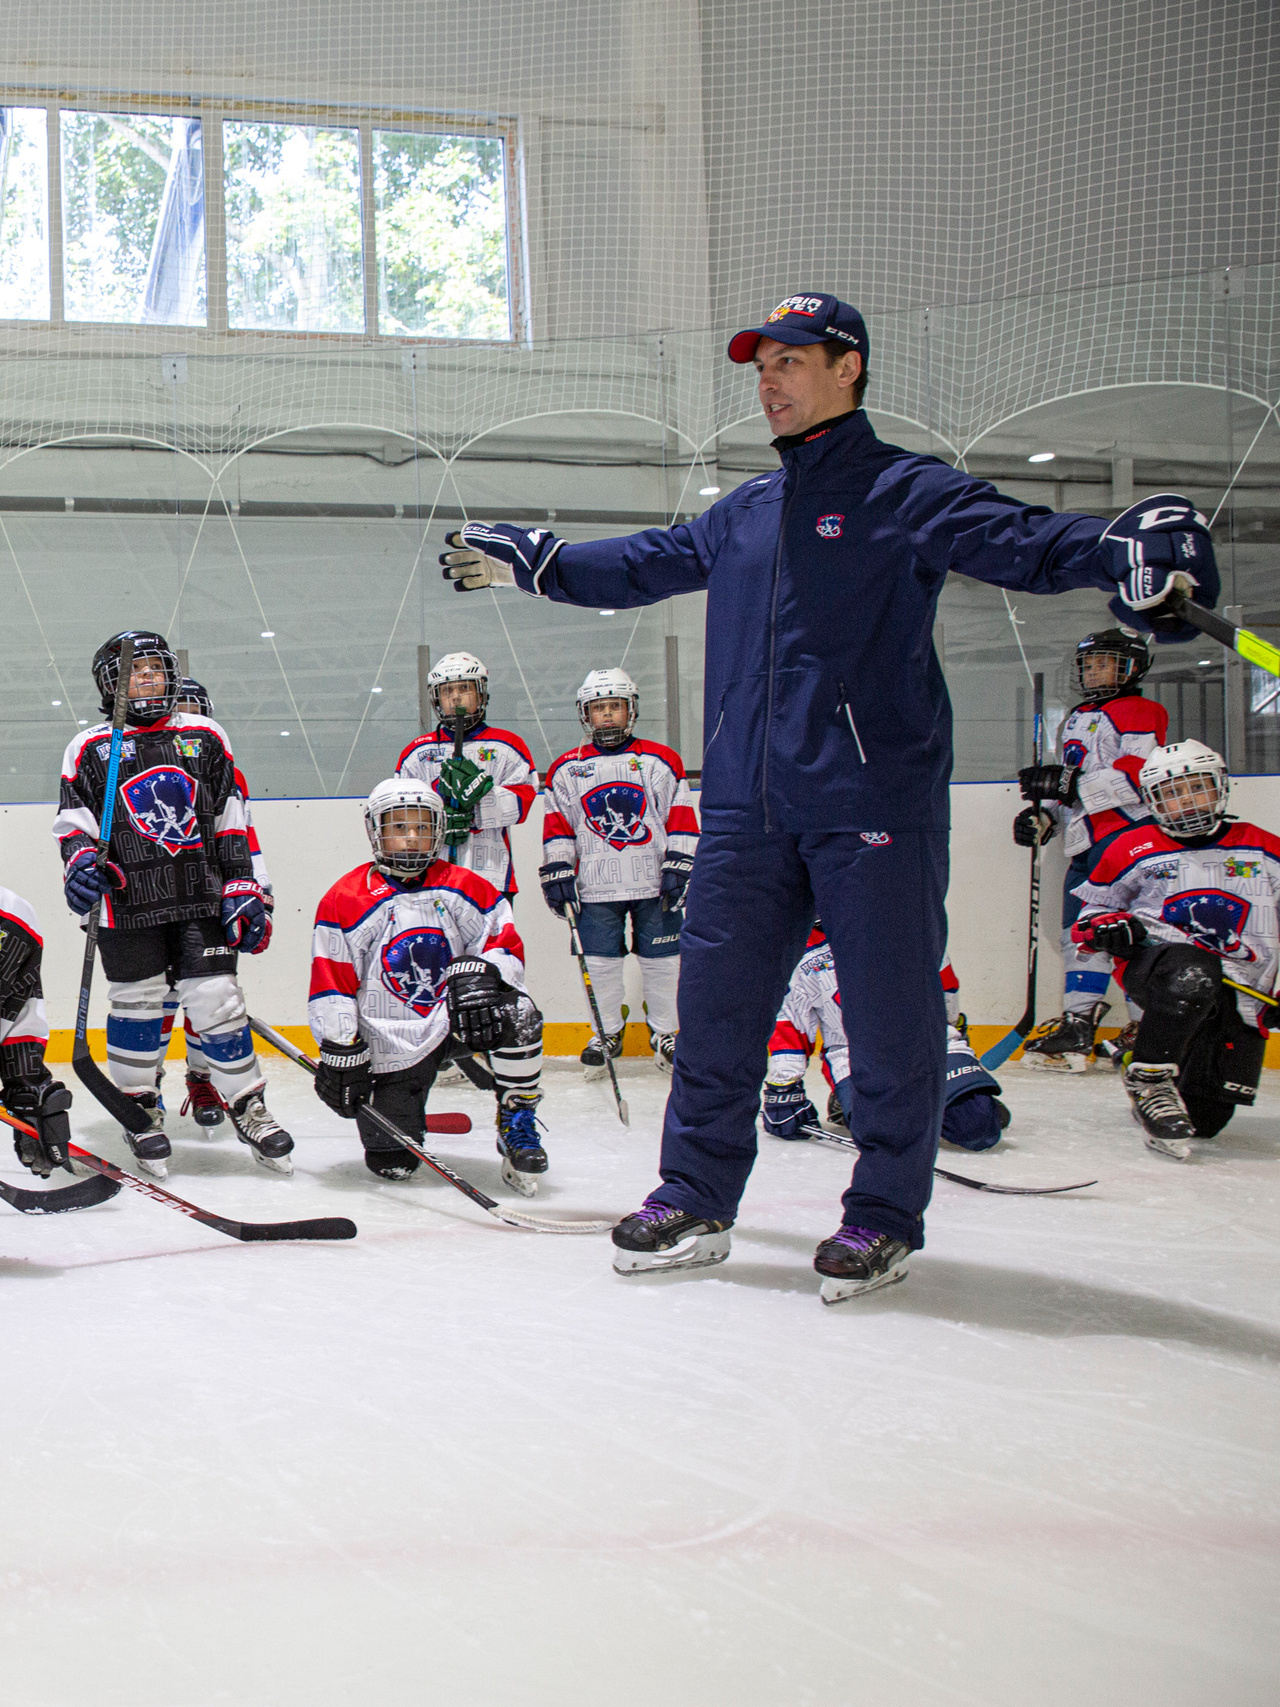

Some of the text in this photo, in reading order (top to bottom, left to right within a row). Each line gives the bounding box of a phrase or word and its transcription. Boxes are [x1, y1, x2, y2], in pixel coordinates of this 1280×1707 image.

[825, 326, 859, 344] CCM
[1144, 567, 1153, 596] CCM
[464, 771, 488, 797] UER
[223, 878, 264, 896] BAU
[651, 931, 680, 946] BAU
[447, 961, 487, 979] RIOR
[75, 987, 89, 1040] BAUER
[946, 1065, 982, 1081] UER
[402, 1135, 463, 1181] BAUER
